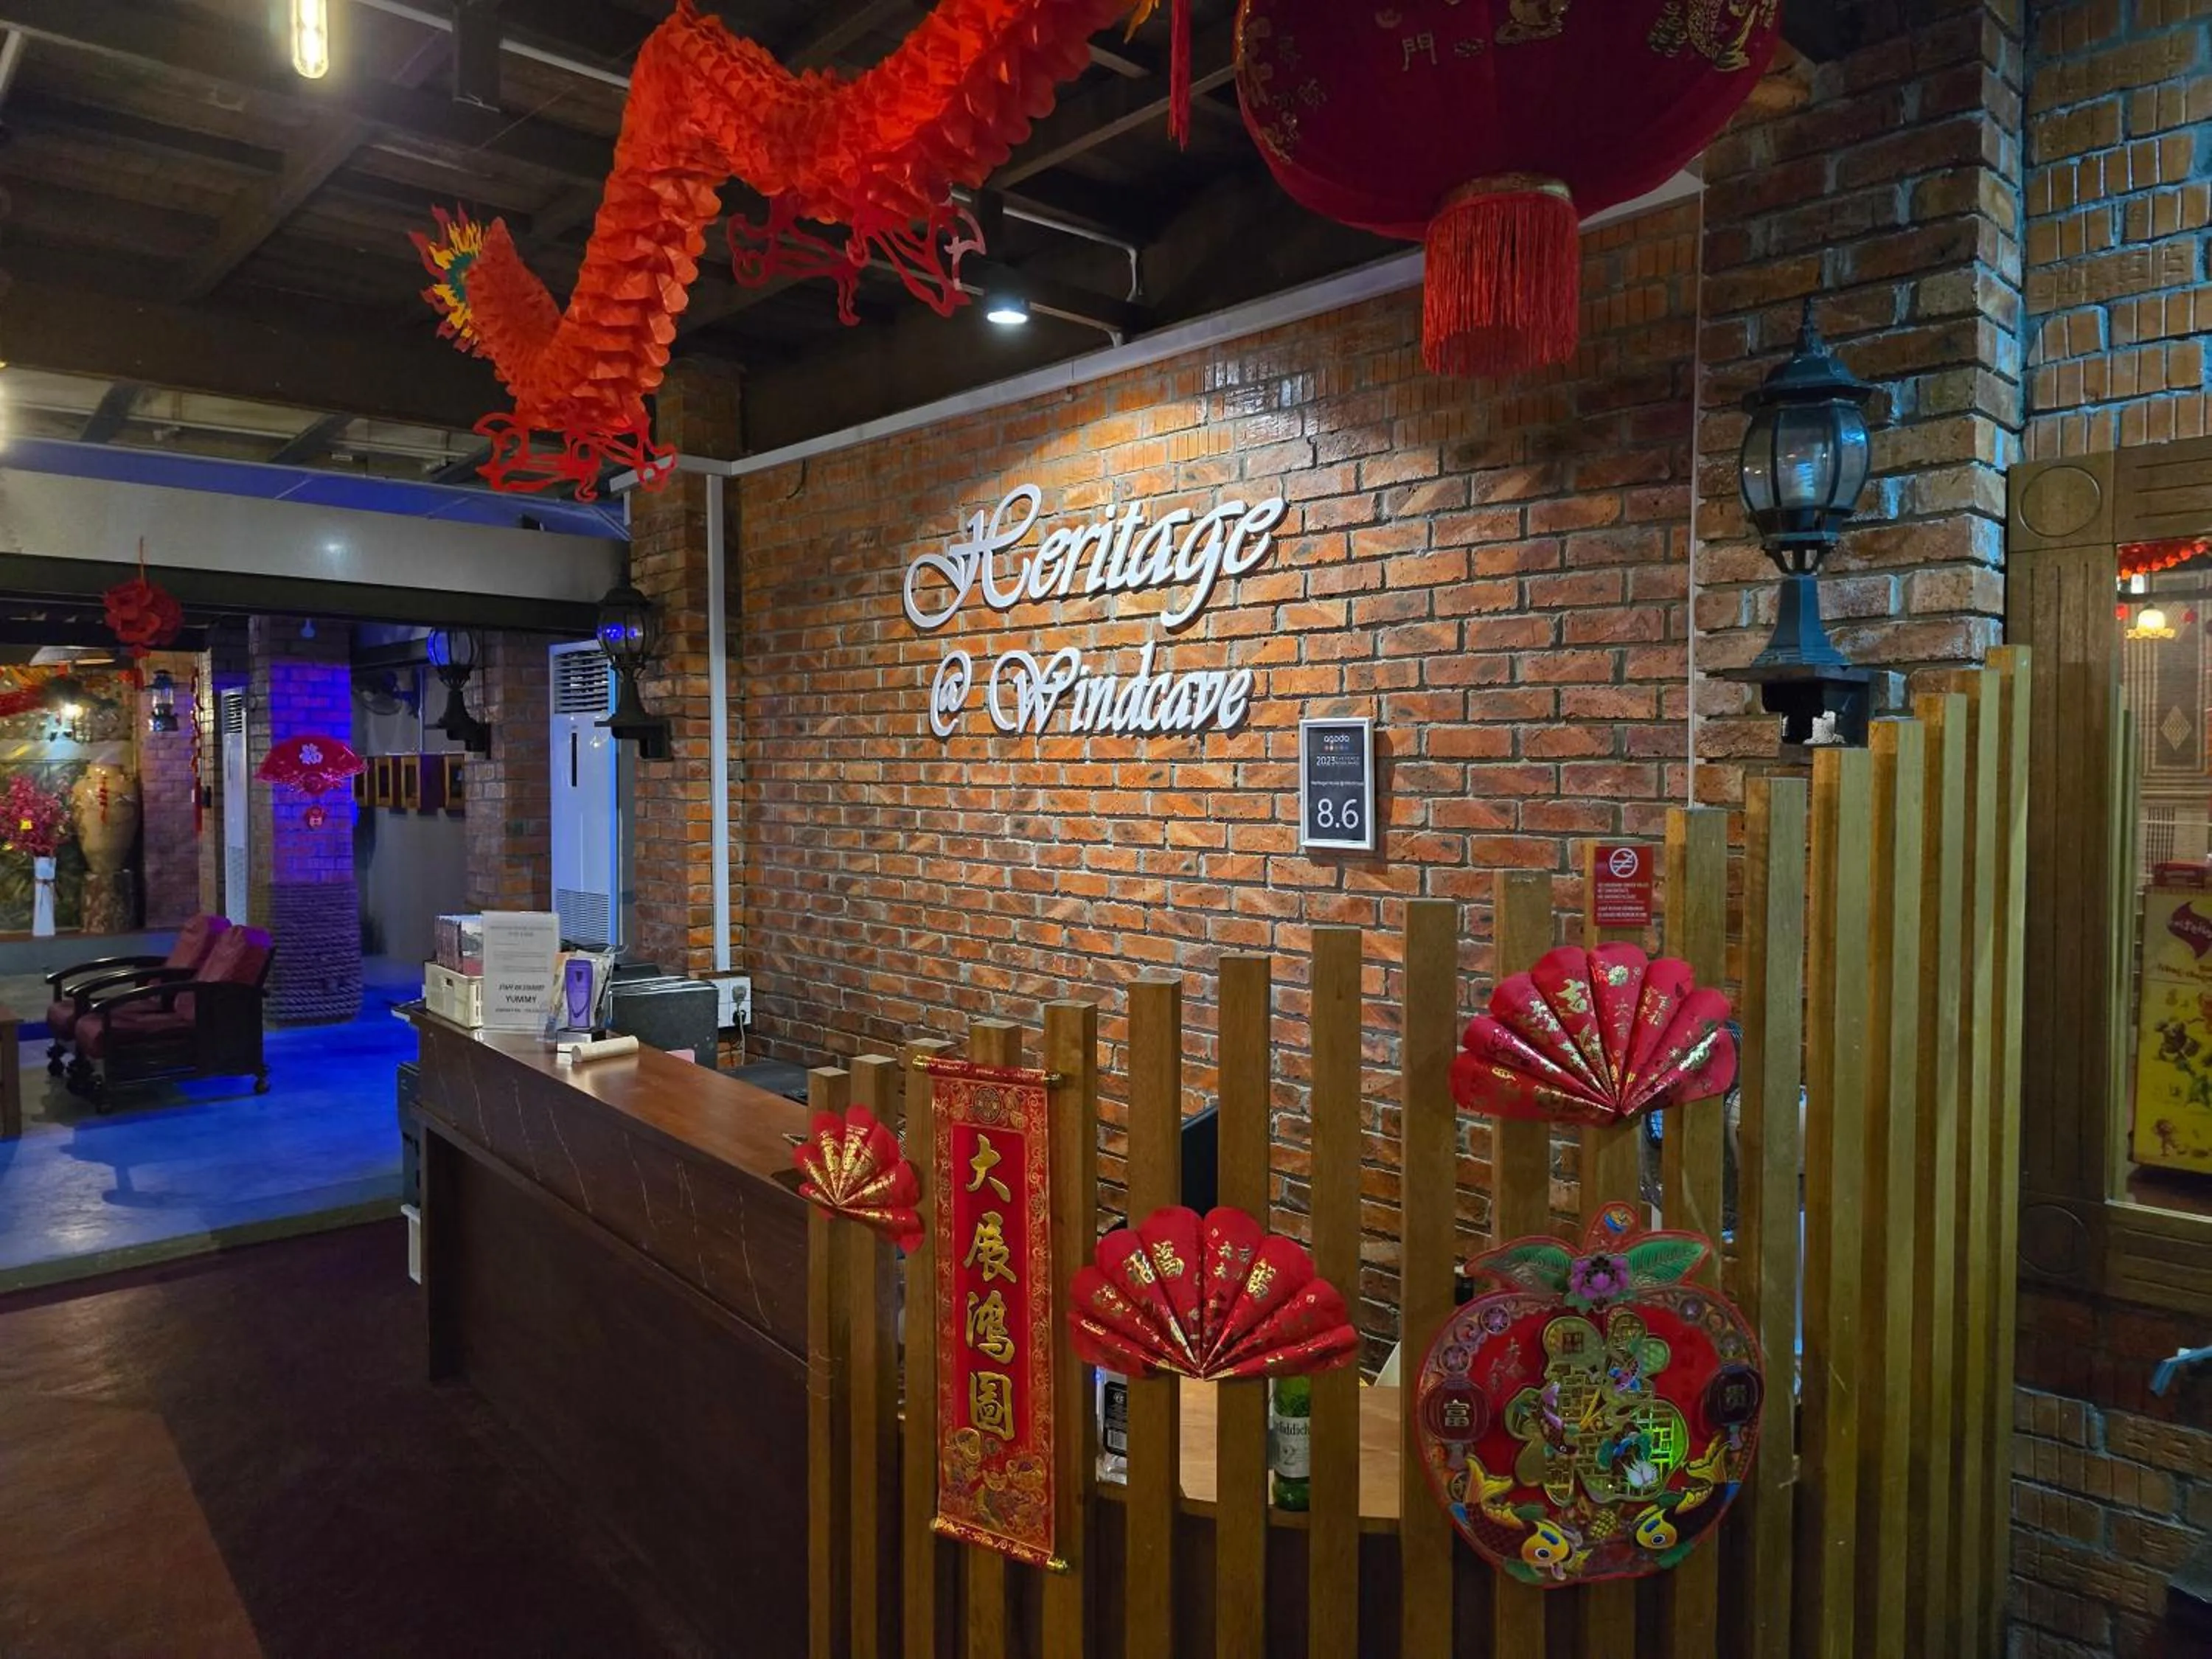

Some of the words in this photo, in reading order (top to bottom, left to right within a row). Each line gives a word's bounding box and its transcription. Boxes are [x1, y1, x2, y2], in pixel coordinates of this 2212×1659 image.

[903, 484, 1287, 628] Heritage
[931, 650, 972, 737] @
[990, 641, 1253, 734] Windcave
[1324, 735, 1350, 744] agoda
[1318, 798, 1359, 829] 8.6
[964, 1133, 1017, 1441] 大展鴻圖
[1443, 1398, 1470, 1427] 富
